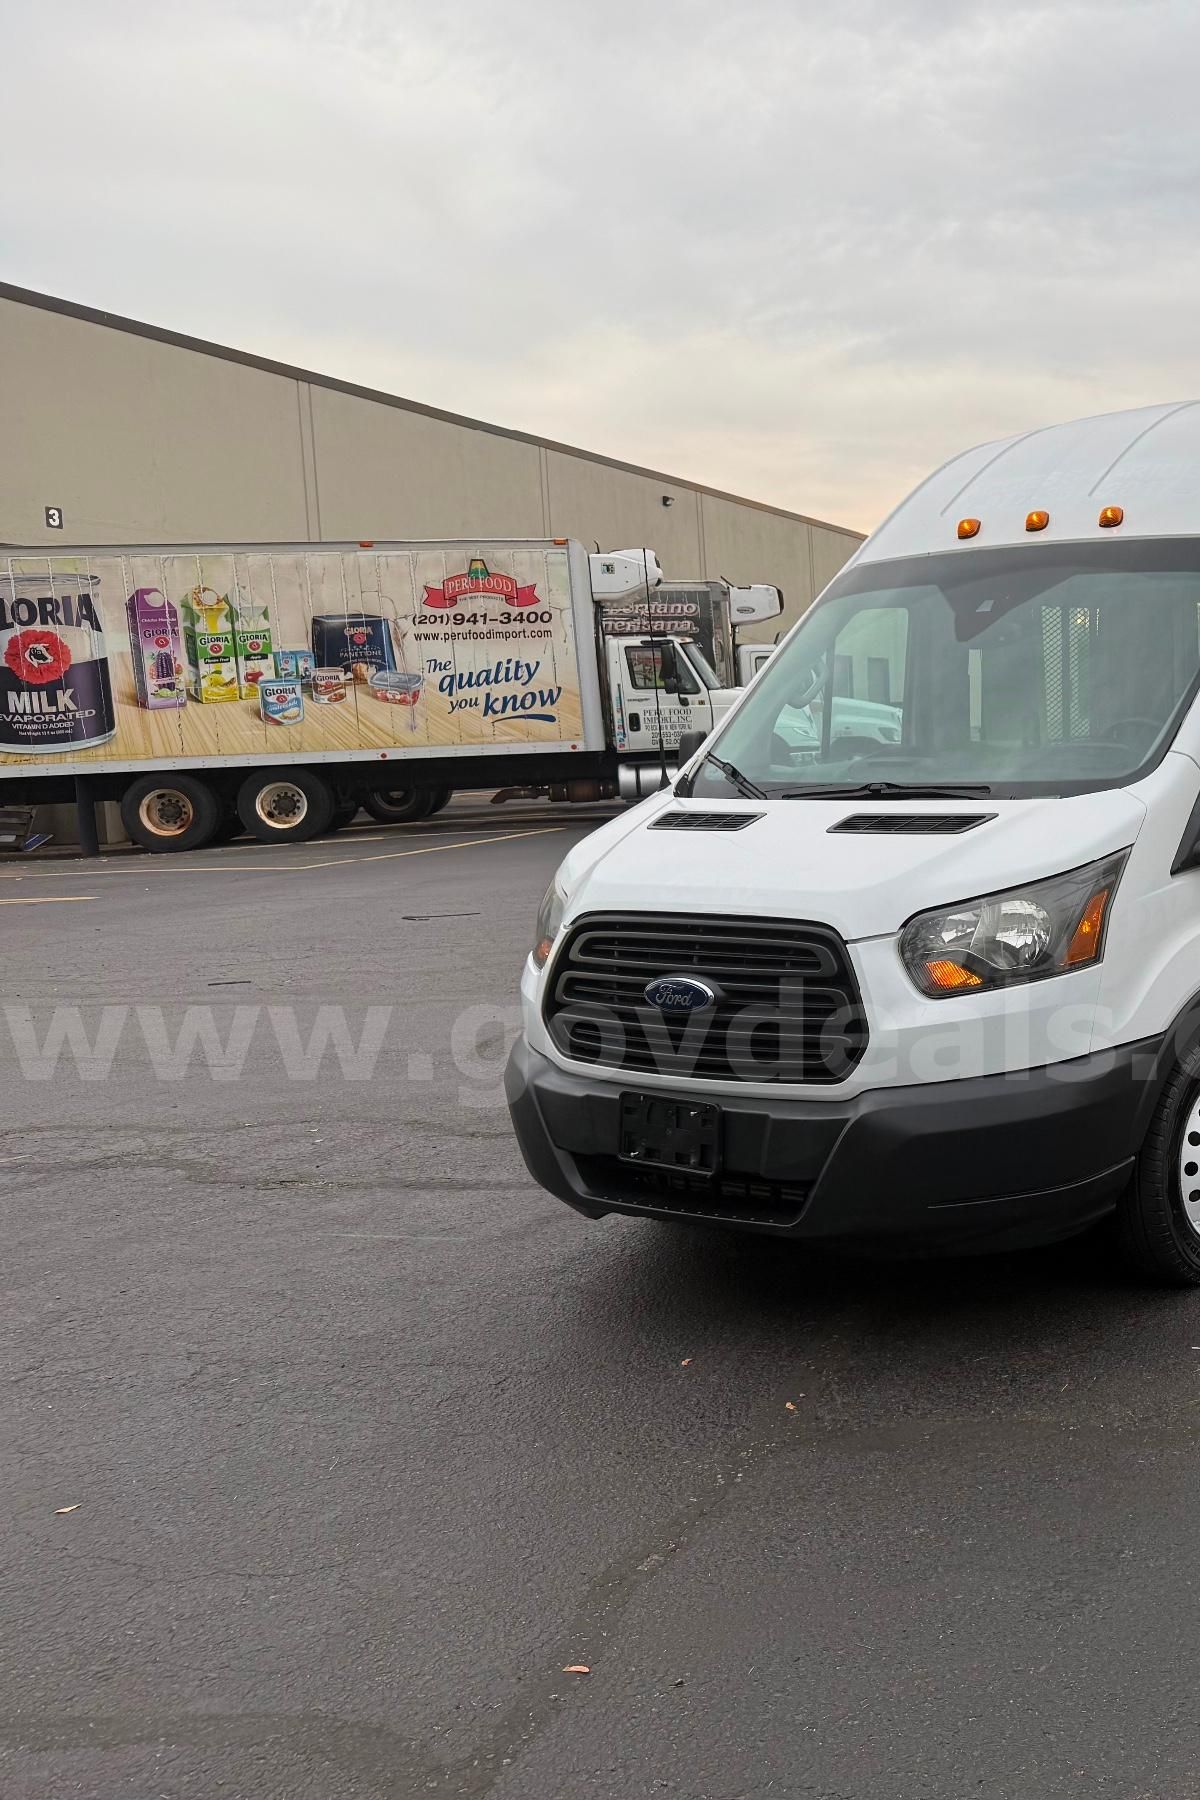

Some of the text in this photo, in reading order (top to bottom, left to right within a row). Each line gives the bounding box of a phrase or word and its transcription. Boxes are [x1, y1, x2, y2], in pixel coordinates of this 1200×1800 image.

[49, 509, 60, 526] 3
[448, 577, 512, 593] PERU FOOD
[144, 628, 178, 639] GLORIA
[199, 635, 230, 646] GLORIA
[239, 634, 268, 643] GLORIA
[413, 629, 553, 643] www.perufoodimport.com
[426, 659, 452, 673] The
[316, 674, 340, 682] GLORIA
[438, 658, 541, 696] quality
[265, 687, 297, 698] GLORIA
[8, 689, 78, 713] MILK
[447, 687, 562, 718] you know
[49, 720, 75, 728] ADDED
[656, 983, 694, 1006] Ford
